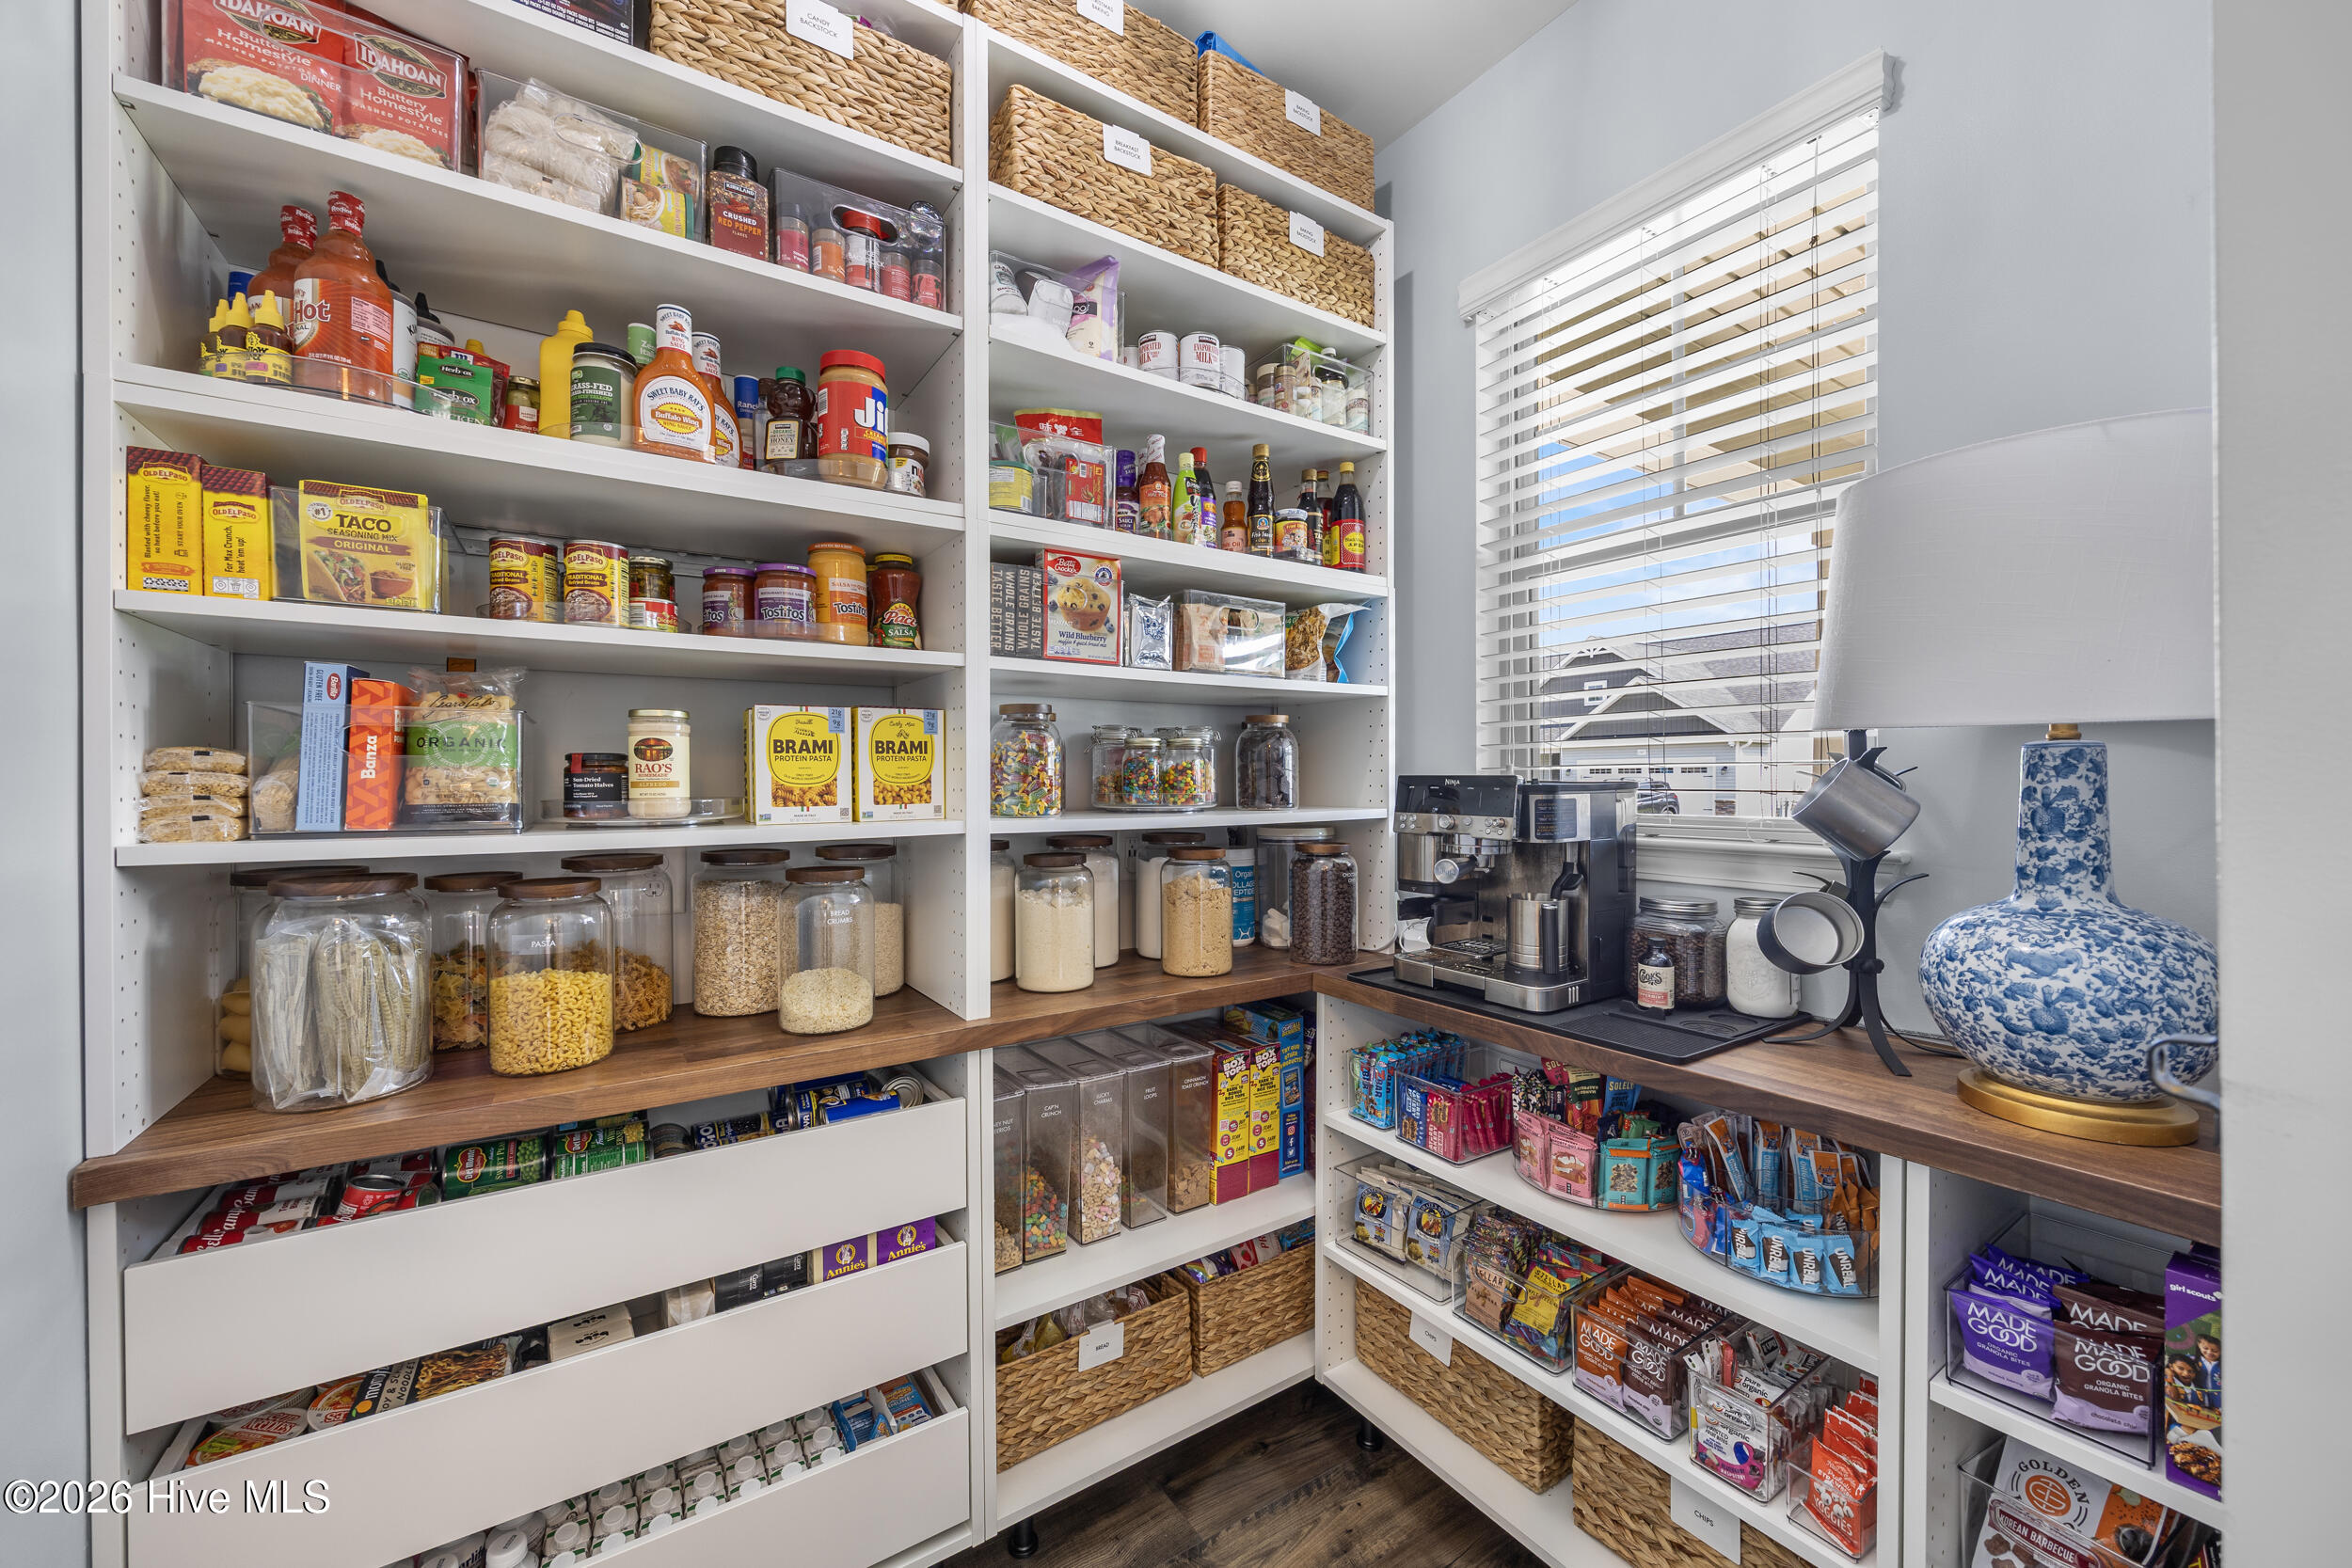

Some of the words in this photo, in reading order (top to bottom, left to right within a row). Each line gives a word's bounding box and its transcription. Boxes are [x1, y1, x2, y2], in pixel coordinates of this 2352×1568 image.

[800, 17, 837, 38] BACKSTOCK
[807, 12, 831, 26] CANDY
[217, 28, 312, 67] Homestyle
[239, 30, 294, 55] Buttery
[360, 44, 442, 87] IDAHOAN
[300, 72, 342, 92] DINNER
[360, 87, 444, 126] Homestyle
[377, 86, 427, 112] Buttery
[352, 102, 393, 119] MASHED
[398, 116, 449, 139] POTATOES
[1114, 145, 1141, 159] BACKSTOCK
[725, 182, 755, 197] KIRKLAND
[331, 204, 353, 215] RedHot
[723, 210, 757, 226] CRUSHED
[718, 215, 733, 228] RED
[735, 219, 762, 236] PEPPER
[1196, 351, 1213, 364] MILK
[647, 387, 669, 401] SWEET
[669, 387, 688, 398] BABY
[688, 391, 706, 412] RAY'S
[655, 411, 682, 422] Buffalo
[682, 416, 700, 428] Wing
[143, 469, 157, 478] OLD
[143, 503, 152, 522] cheesy
[314, 507, 326, 516] #1
[335, 514, 392, 532] TACO
[224, 526, 233, 546] Crunch,
[326, 528, 380, 541] SEASONING
[381, 534, 399, 543] MIX
[225, 547, 233, 561] Max
[334, 539, 392, 554] ORIGINAL
[225, 562, 233, 573] For
[237, 561, 246, 573] heat
[1054, 564, 1078, 574] Crocker
[1057, 557, 1076, 570] Betty
[992, 570, 1004, 603] TASTE
[1004, 571, 1015, 610] WHOLE
[1018, 569, 1030, 610] GRAINS
[1031, 573, 1042, 615] BETTER
[888, 627, 914, 637] SALSA
[990, 606, 1002, 649] BETTER
[1004, 611, 1015, 651] GRAINS
[1017, 612, 1029, 649] WHOLE
[1030, 618, 1041, 650] TASTE
[1058, 630, 1074, 640] Wild
[1075, 632, 1107, 643] Blueberry
[329, 674, 339, 699] Barilla
[315, 689, 324, 703] FREE
[421, 692, 497, 721] Garofalo
[926, 711, 936, 720] 21g
[416, 736, 507, 751] ORGANIC
[772, 738, 834, 754] BRAMI
[875, 739, 929, 754] BRAMI
[360, 735, 378, 781] Banza
[634, 763, 673, 774] RAO'S
[1444, 778, 1461, 787] NINJA
[827, 916, 853, 925] CRUMBS
[531, 940, 557, 948] PASTA
[1223, 1055, 1246, 1072] BOX
[1254, 1049, 1277, 1064] BOX
[1256, 1056, 1279, 1071] TOPS
[1184, 1076, 1207, 1085] CINNAMON
[1224, 1065, 1248, 1079] TOPS
[1193, 1080, 1209, 1088] CRUNCH
[1609, 1081, 1635, 1091] SOLELY
[1093, 1097, 1113, 1105] CHARMS
[1096, 1091, 1110, 1100] LUCKY
[1143, 1092, 1158, 1101] LOOPS
[1041, 1109, 1062, 1118] CRUNCH
[465, 1148, 476, 1167] Monte
[465, 1168, 474, 1180] Del
[887, 1241, 927, 1261] Annie's
[1768, 1234, 1785, 1274] UNREAL
[826, 1259, 866, 1280] Annie's
[1800, 1246, 1818, 1287] UNREAL
[1834, 1246, 1854, 1289] UNREAL
[1534, 1269, 1567, 1292] STELLAR
[2169, 1283, 2186, 1293] girl
[2185, 1289, 2217, 1302] scouts
[1967, 1302, 2038, 1338] MADE
[2070, 1303, 2148, 1333] MADE
[1424, 1329, 1438, 1342] CHIPS
[1581, 1321, 1617, 1352] MADE
[1649, 1323, 1692, 1349] MADE
[1967, 1317, 2038, 1354] GOOD
[1579, 1333, 1613, 1362] GOOD
[1635, 1340, 1668, 1372] MADE
[1977, 1341, 2009, 1363] GRANOLA
[2010, 1355, 2032, 1369] BITES
[1987, 1341, 2019, 1359] ORGANIC
[1631, 1350, 1666, 1382] GOOD
[2074, 1354, 2151, 1385] GOOD
[396, 1360, 416, 1402] NOODLES
[1743, 1376, 1762, 1388] pure
[2096, 1379, 2131, 1392] ORGANIC
[1741, 1382, 1769, 1399] organic
[2084, 1384, 2121, 1398] GRANOLA
[2122, 1391, 2145, 1402] BITES
[2090, 1411, 2122, 1427] chocolate
[2123, 1420, 2138, 1432] chip
[1720, 1467, 1747, 1481] RASPBERRY
[2017, 1458, 2090, 1506] GOLDEN
[1693, 1509, 1715, 1528] CHIPS
[1813, 1493, 1853, 1538] YOGGIES
[1999, 1512, 2029, 1538] KOREAN
[2029, 1529, 2075, 1563] BARBECUE
